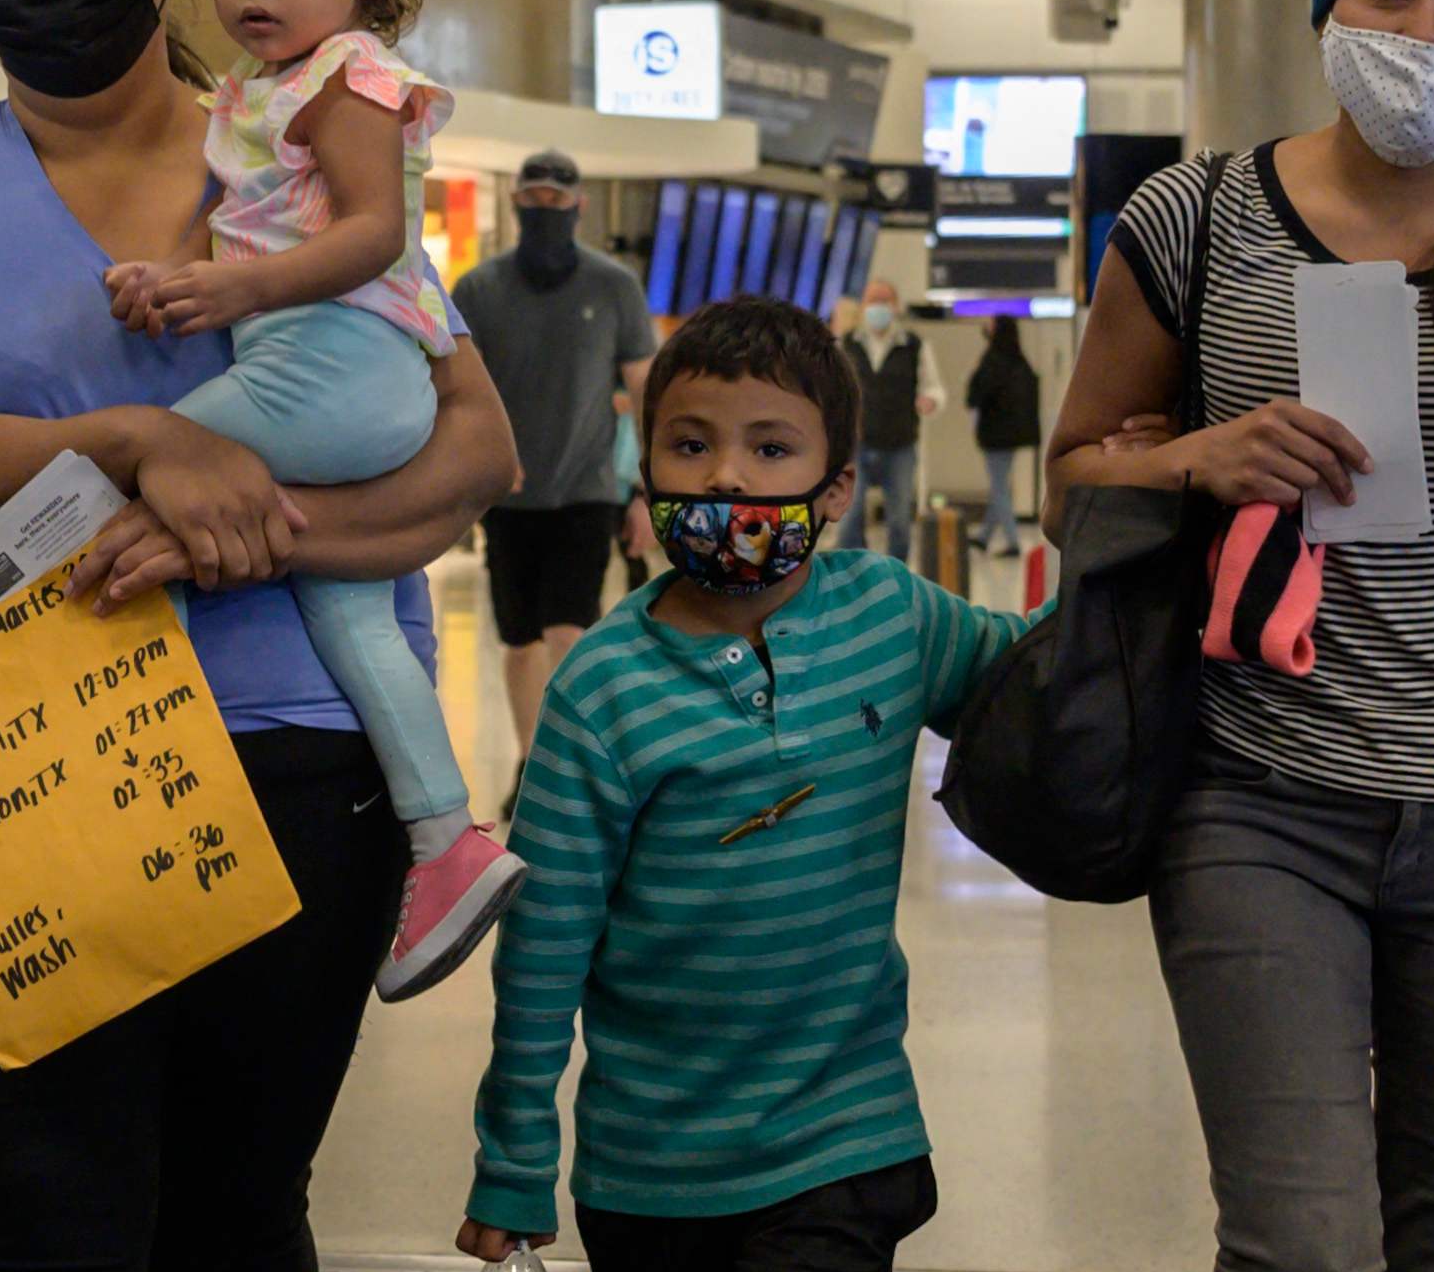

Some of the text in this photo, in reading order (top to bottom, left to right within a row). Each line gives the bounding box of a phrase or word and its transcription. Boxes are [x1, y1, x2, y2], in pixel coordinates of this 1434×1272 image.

[159, 770, 201, 810] pm
[194, 850, 239, 894] pm
[0, 934, 78, 1001] Wash
